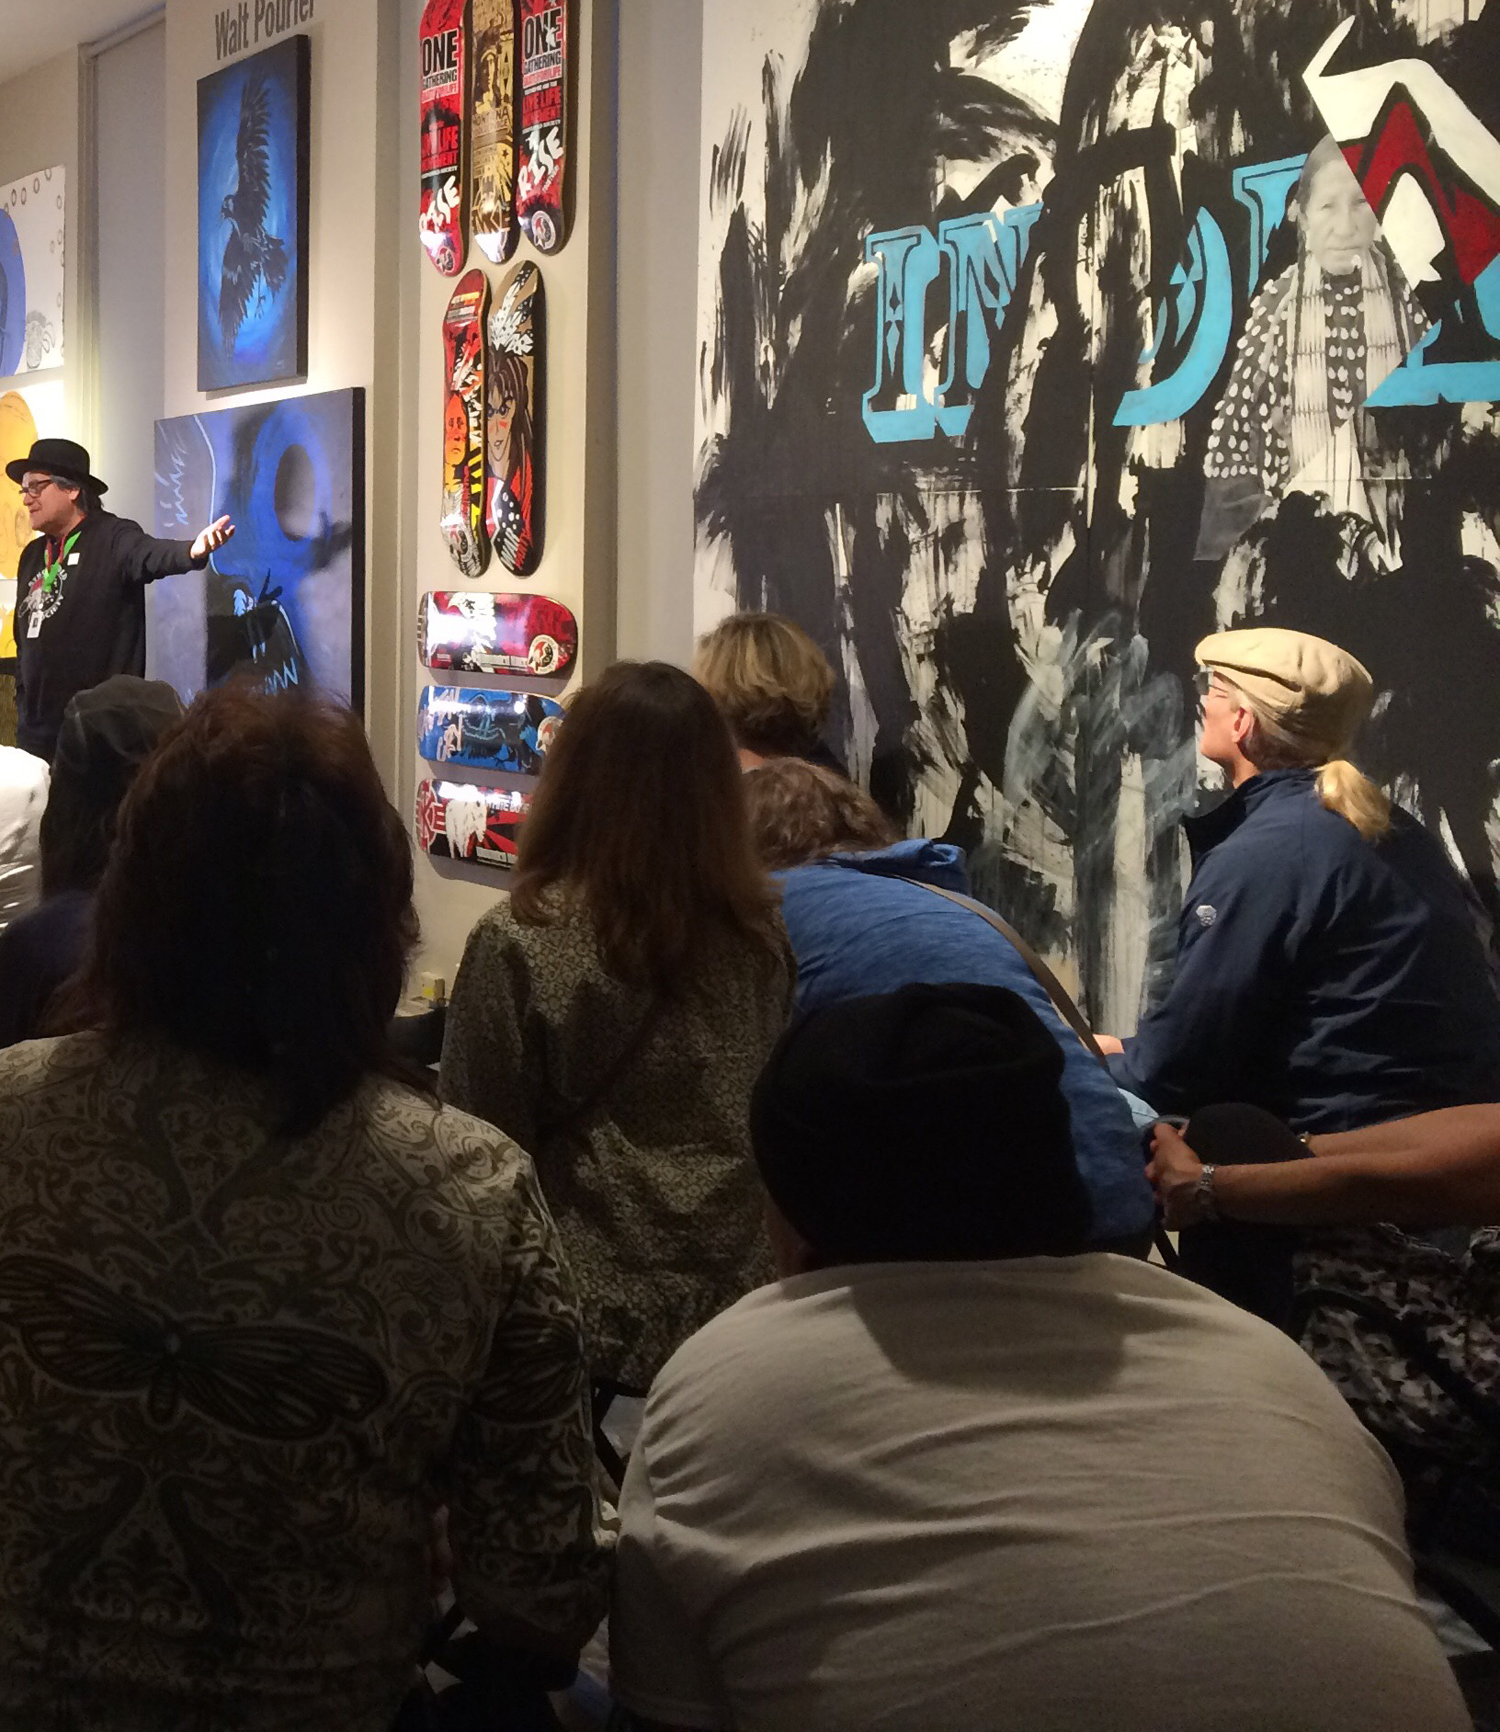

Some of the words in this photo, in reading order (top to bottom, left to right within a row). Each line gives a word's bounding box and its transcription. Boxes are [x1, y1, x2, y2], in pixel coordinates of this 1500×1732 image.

[215, 1, 249, 60] Walt
[422, 29, 459, 77] ONE
[524, 8, 563, 59] ONE
